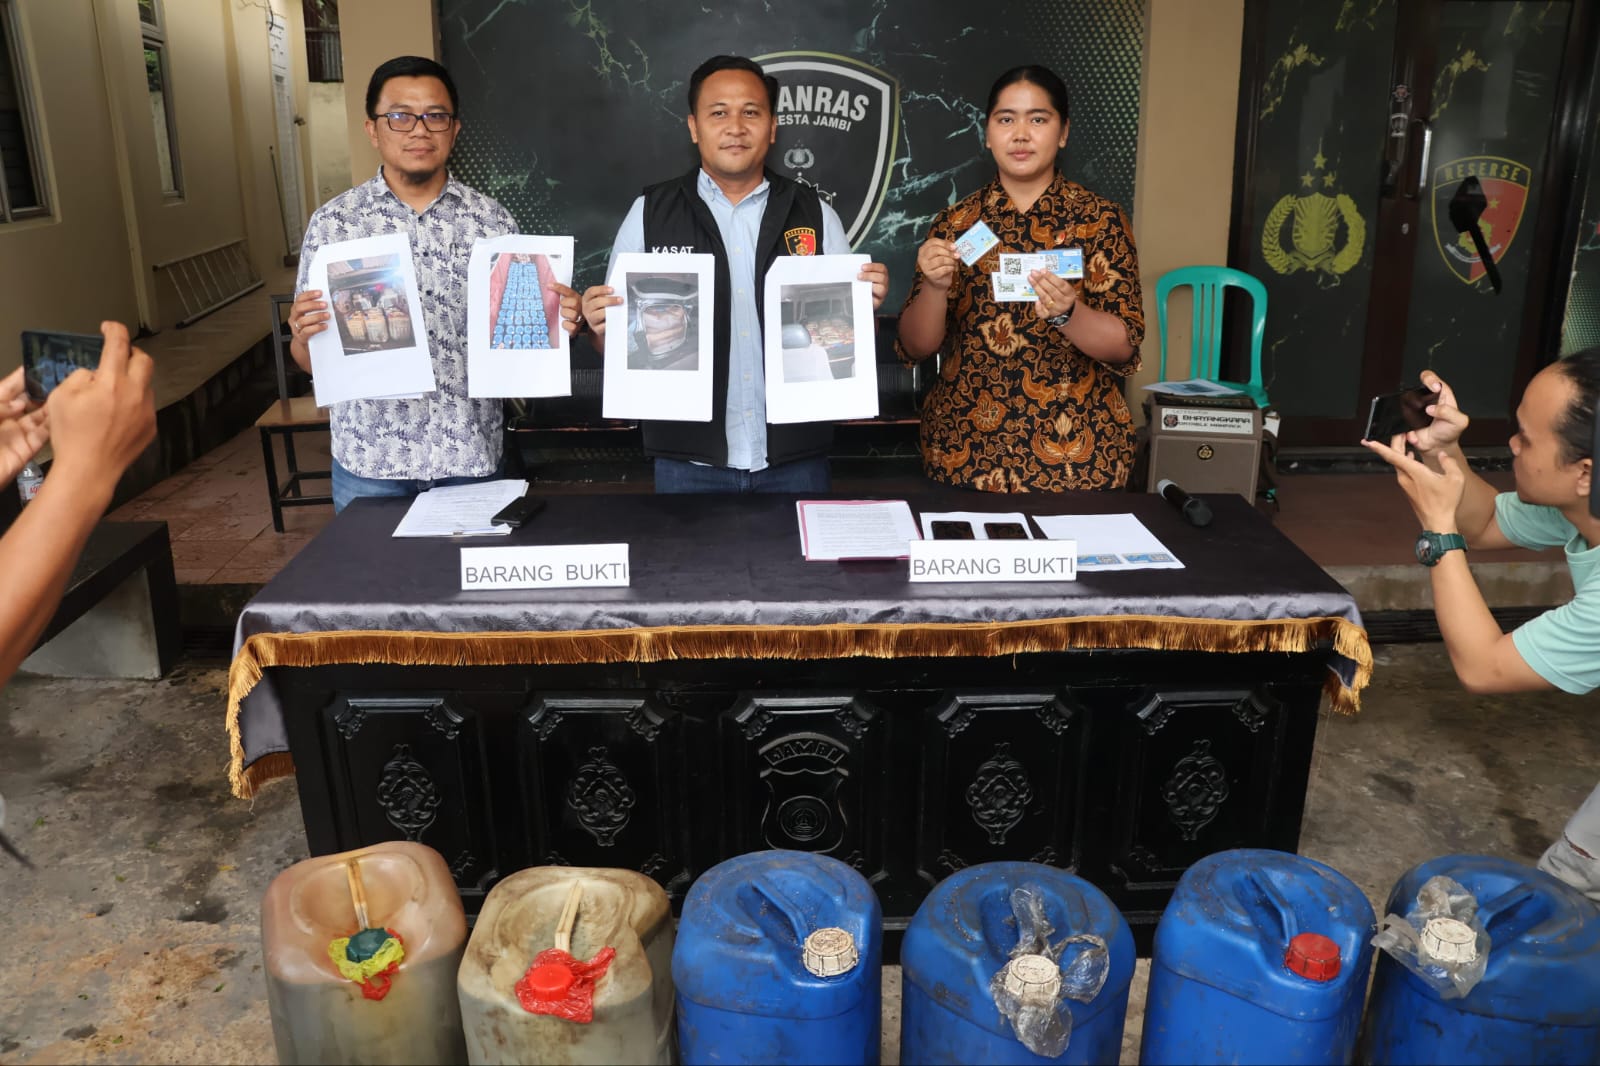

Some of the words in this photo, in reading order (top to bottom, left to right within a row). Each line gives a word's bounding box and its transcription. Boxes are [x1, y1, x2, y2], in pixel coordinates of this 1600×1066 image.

[776, 113, 809, 126] ESTA
[813, 115, 852, 132] JAMBI
[1444, 162, 1521, 181] RESERSE
[652, 245, 694, 254] KASAT
[465, 565, 553, 583] BARANG
[566, 563, 627, 581] BUKTI
[913, 558, 1001, 575] BARANG
[1014, 557, 1074, 574] BUKTI
